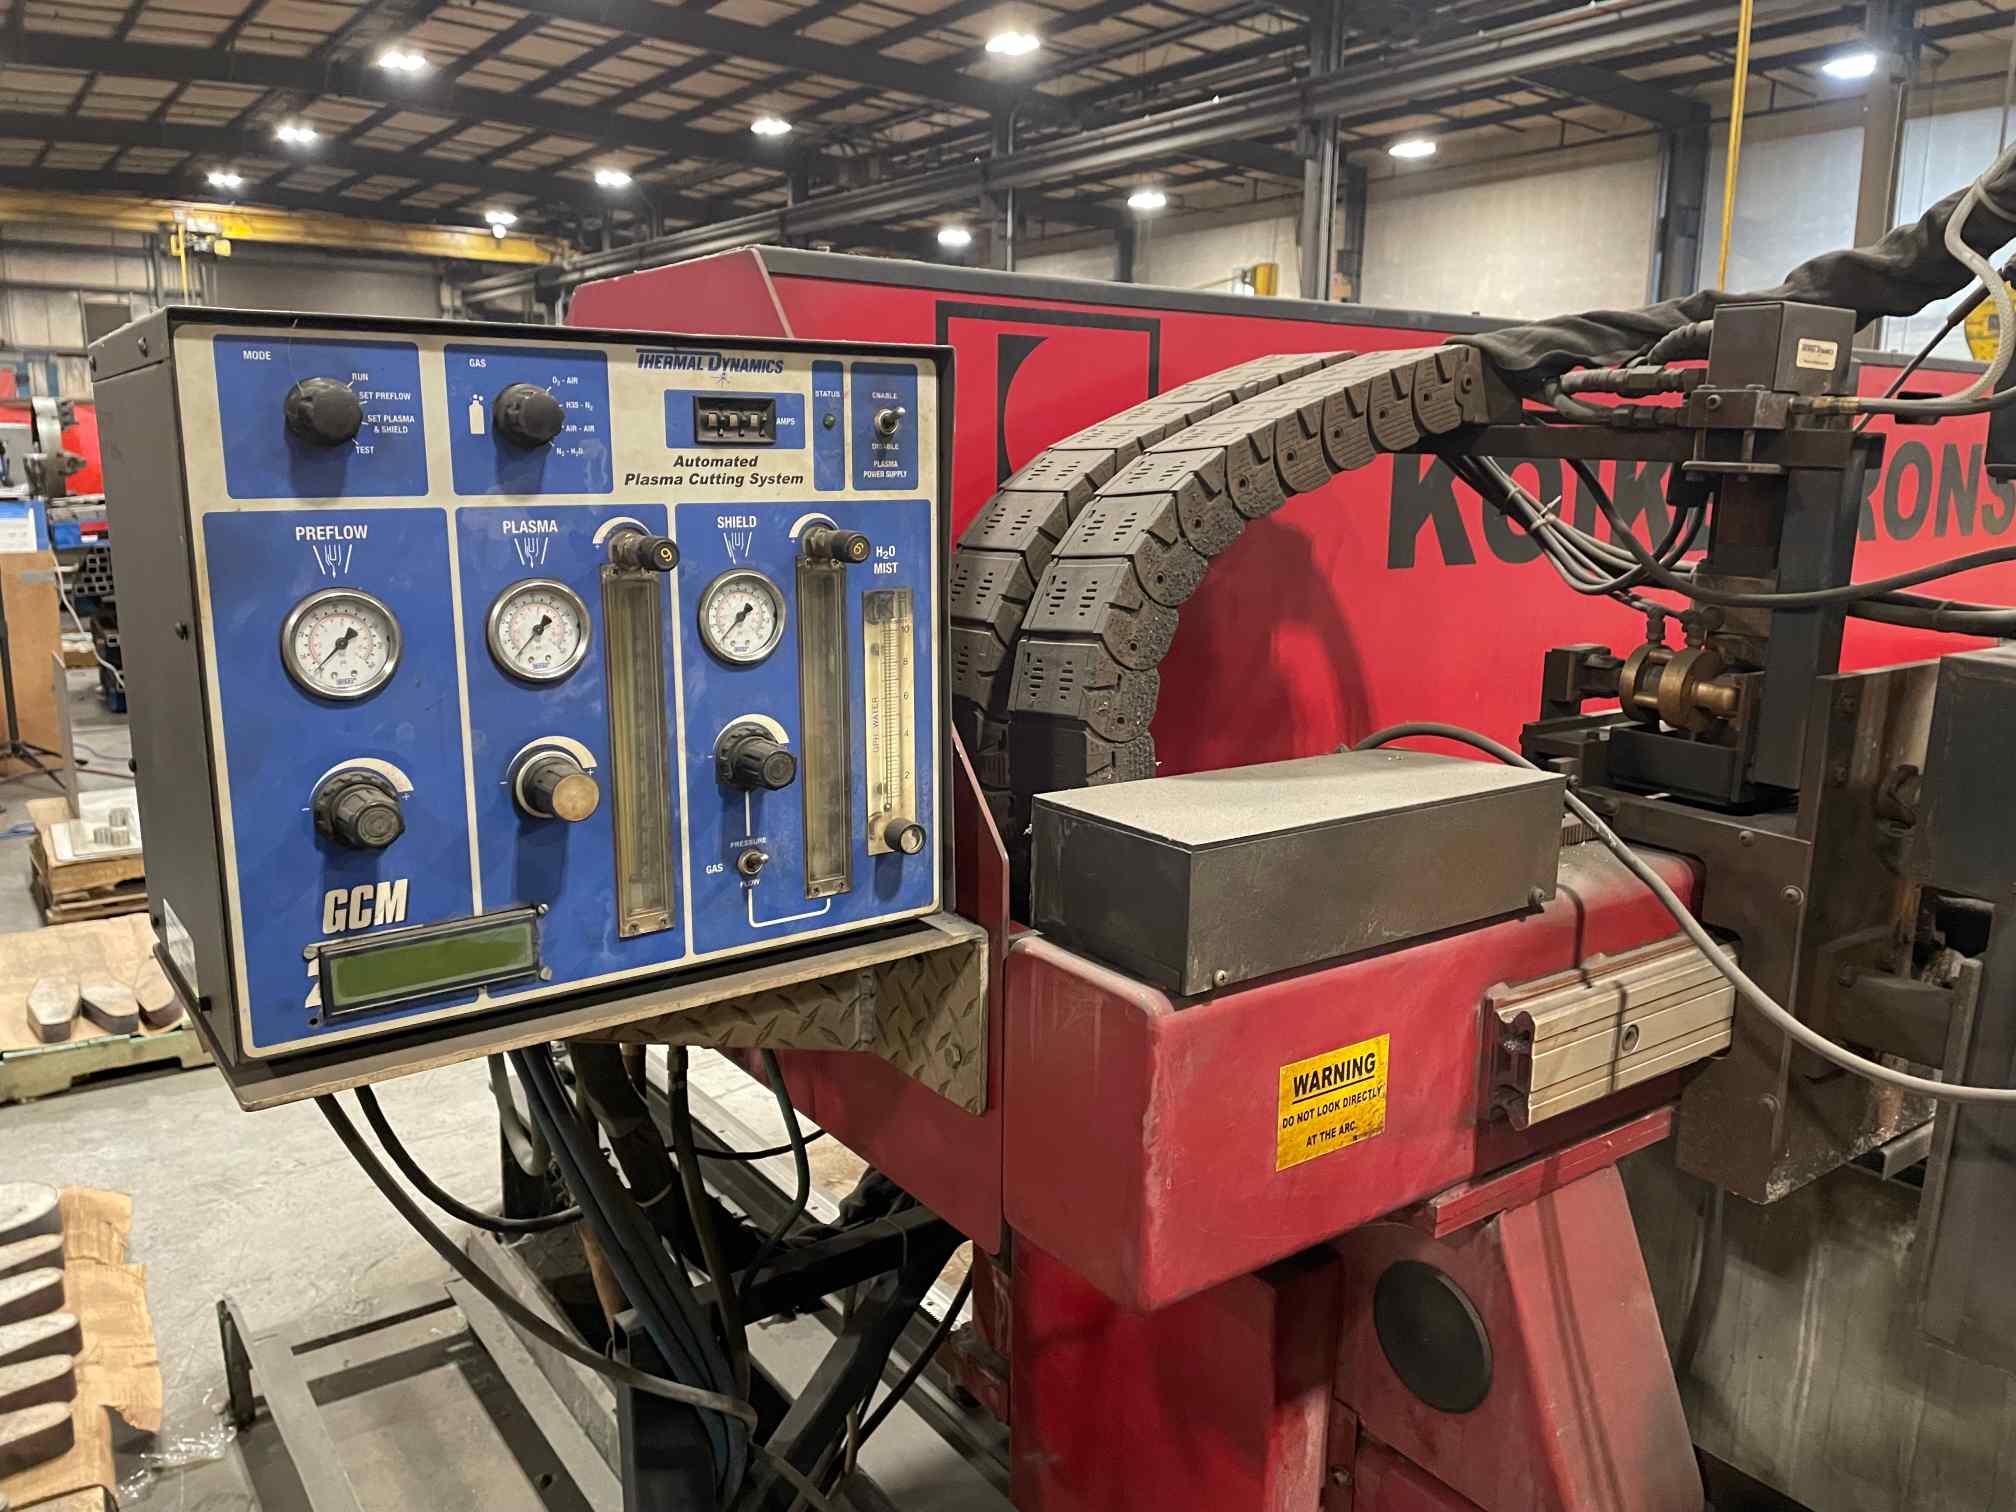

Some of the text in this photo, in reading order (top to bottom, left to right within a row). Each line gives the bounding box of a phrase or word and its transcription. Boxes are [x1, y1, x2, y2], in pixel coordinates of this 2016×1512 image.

[243, 350, 272, 361] MODE
[636, 348, 784, 374] THERMAL DYNAMICS
[469, 358, 487, 368] GAS
[352, 372, 369, 381] RUN
[566, 377, 578, 385] AIR
[359, 391, 411, 401] SET PREFLOW
[815, 390, 841, 398] STATUS
[367, 414, 415, 424] SET PLASMA
[776, 416, 796, 425] AMPS
[381, 426, 408, 434] SHIELD
[565, 424, 577, 432] AIR
[583, 424, 595, 432] AIR
[356, 446, 374, 455] TEST
[673, 455, 758, 468] Automated
[624, 472, 804, 487] Plasma Cutting System
[885, 470, 908, 478] SUPPLY
[502, 519, 559, 534] PLASMA
[717, 515, 757, 529] SHIELD
[295, 525, 368, 541] PREFLOW
[874, 561, 898, 574] MIST
[904, 771, 911, 780] 2
[706, 863, 724, 874] GAS
[322, 878, 409, 935] GCM
[1294, 1053, 1375, 1097] WARNING
[1282, 1085, 1383, 1129] DO NOT LOOK DIRECTLY
[1306, 1134, 1317, 1148] AT
[1319, 1127, 1337, 1143] THE
